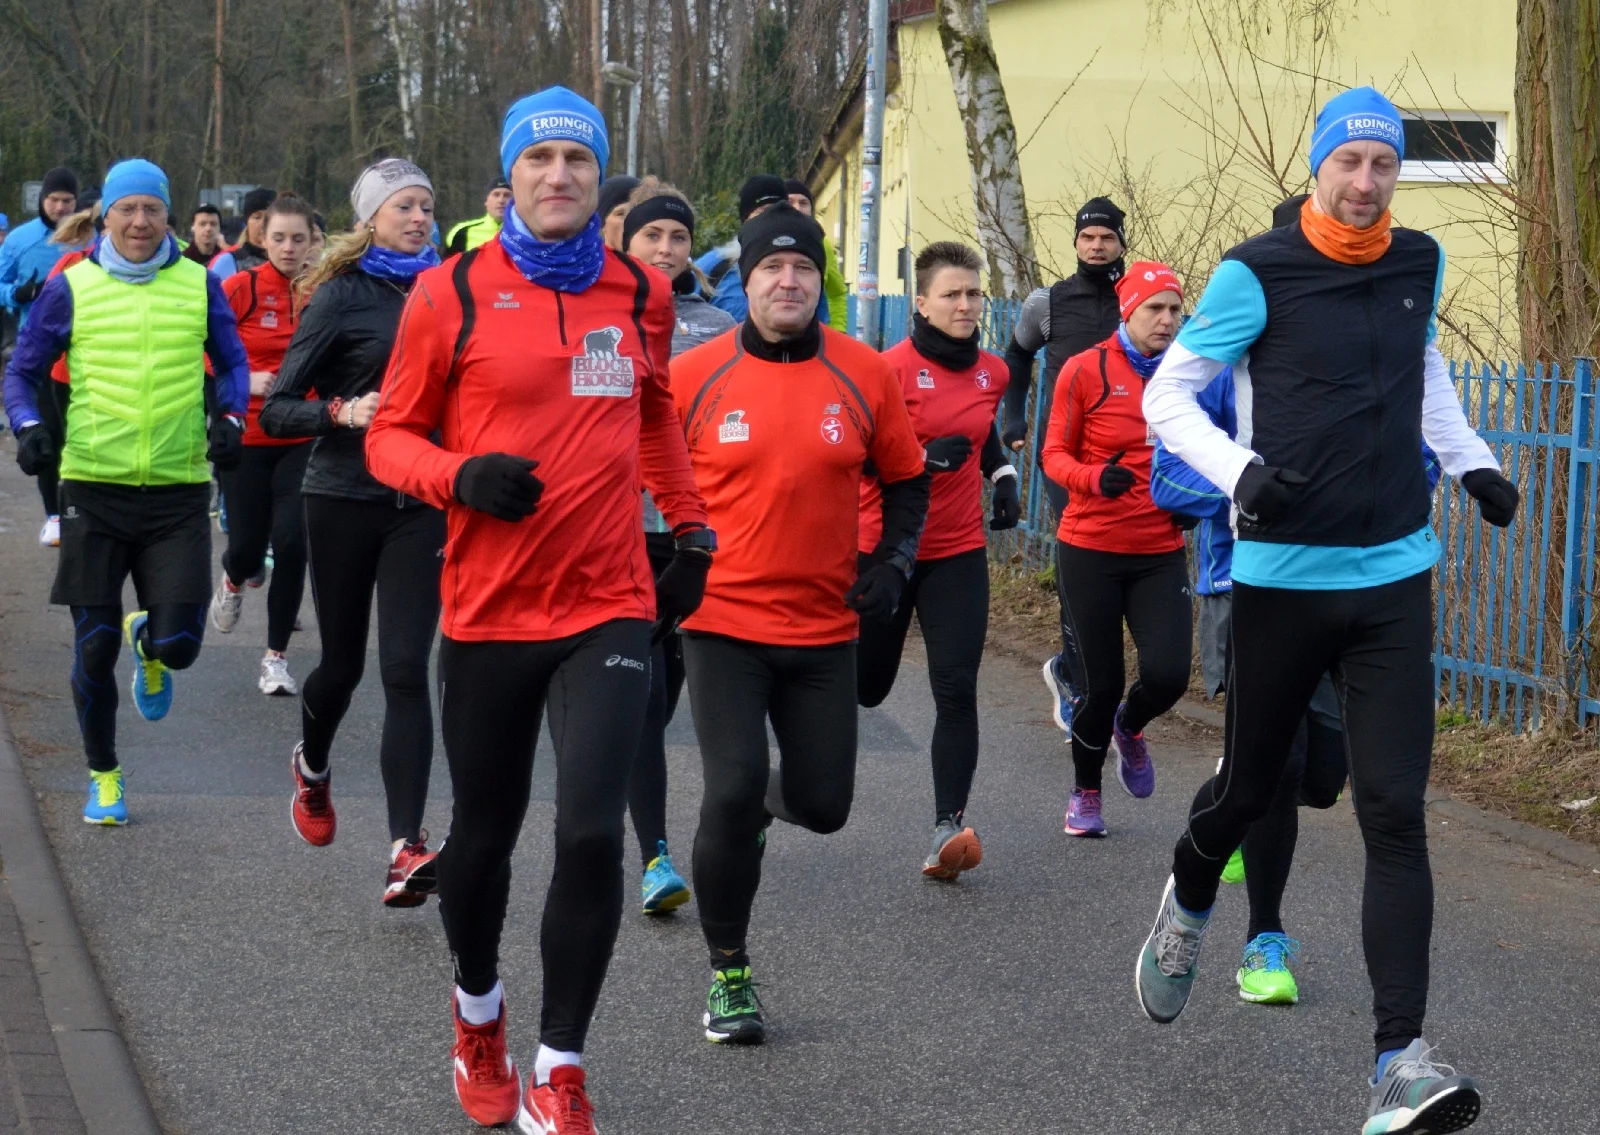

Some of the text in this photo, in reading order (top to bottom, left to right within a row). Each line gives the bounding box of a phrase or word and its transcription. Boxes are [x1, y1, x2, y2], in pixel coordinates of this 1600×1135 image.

[532, 116, 594, 137] ERDINGER
[1347, 118, 1400, 138] ERDINGER
[574, 357, 632, 372] BLOCK
[574, 372, 633, 387] HOUSE
